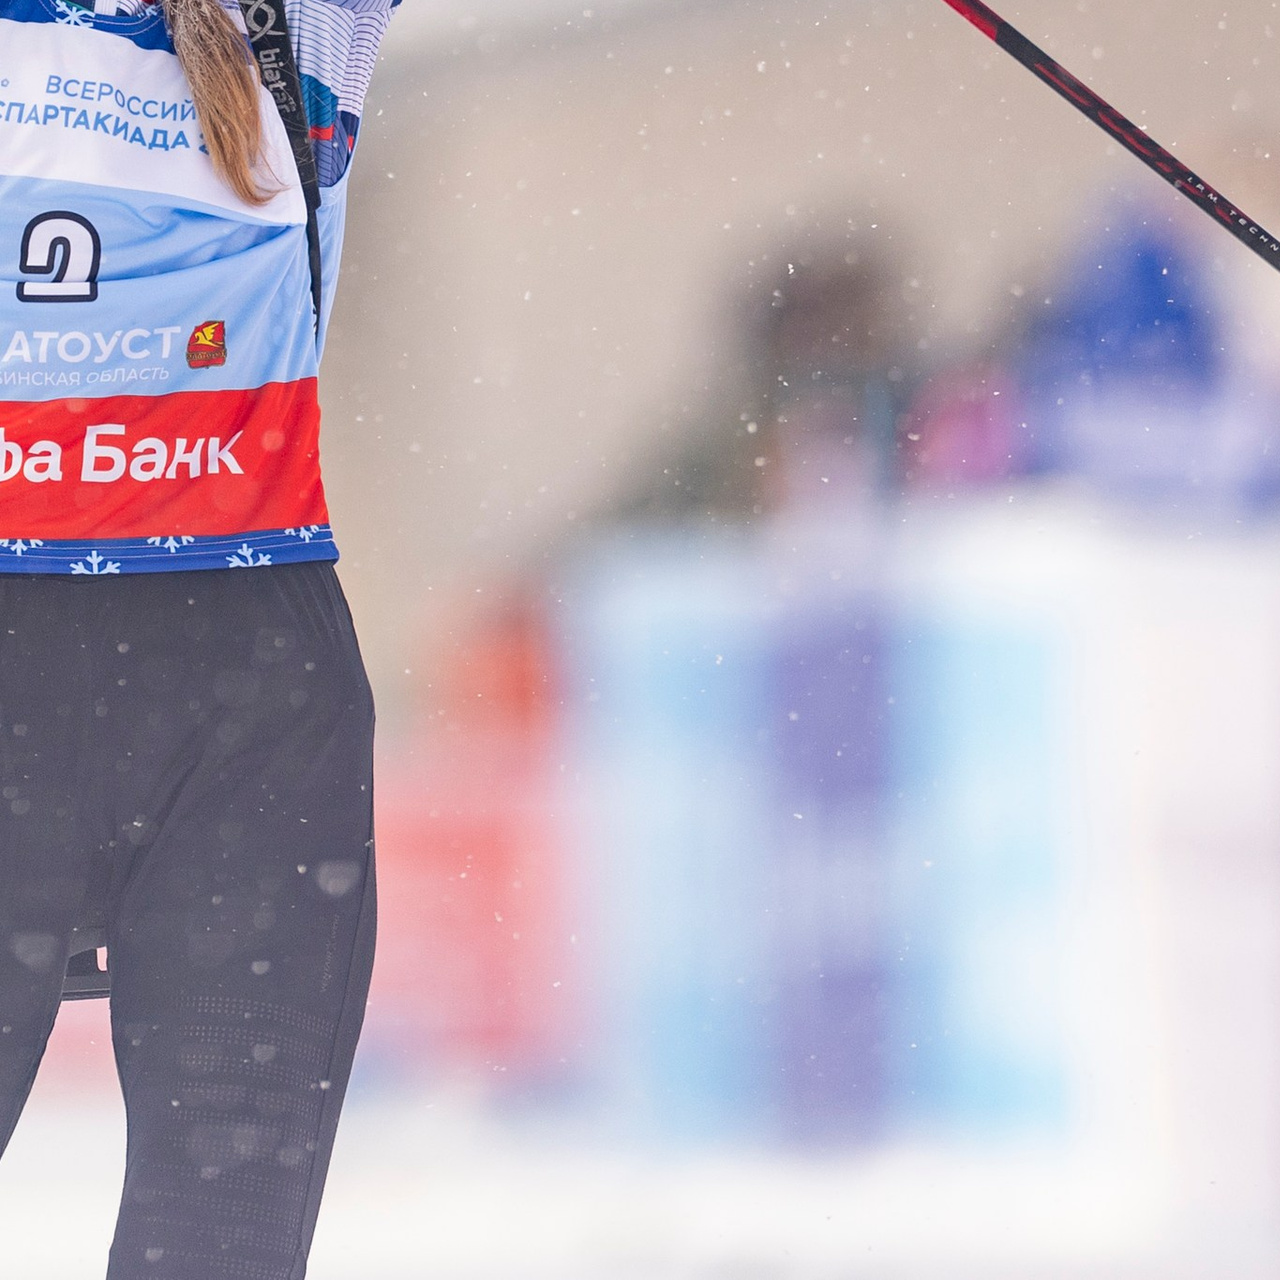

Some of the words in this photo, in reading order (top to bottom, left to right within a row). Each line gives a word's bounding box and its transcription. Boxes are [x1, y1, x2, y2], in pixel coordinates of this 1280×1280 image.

[45, 75, 197, 121] ВСЕРОССИЙ
[258, 47, 291, 115] biatar
[16, 210, 101, 303] 2
[86, 367, 169, 383] ОБЛАСТЬ
[80, 424, 245, 483] Банк
